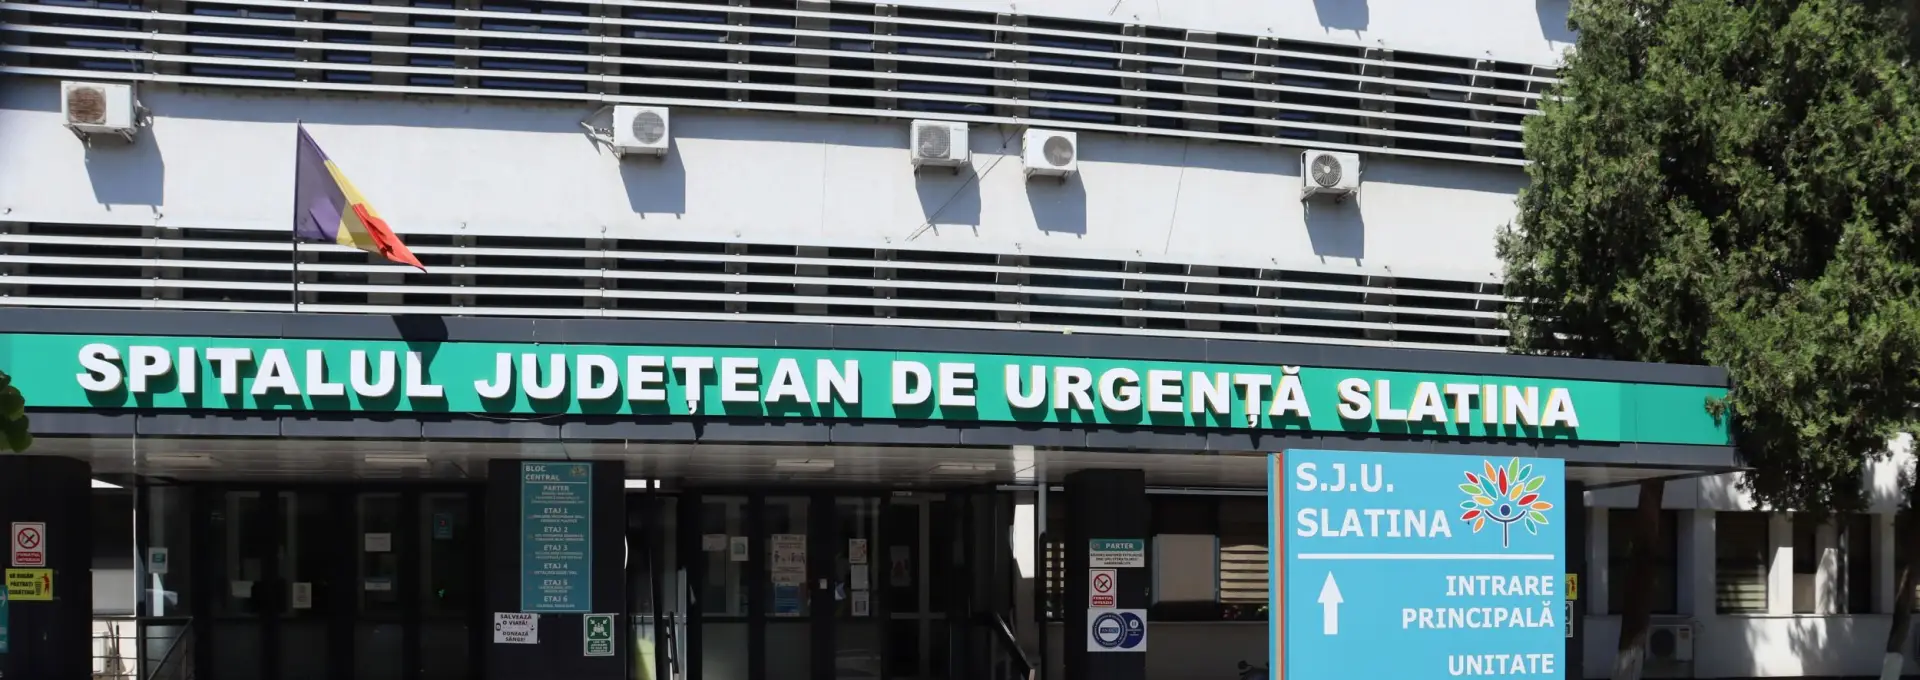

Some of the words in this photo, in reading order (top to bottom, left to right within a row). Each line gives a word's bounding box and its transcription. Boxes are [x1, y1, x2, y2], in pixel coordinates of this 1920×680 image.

[76, 342, 443, 398] SPITALUL
[473, 352, 859, 415] JUDEȚEAN
[891, 360, 976, 407] DE
[1005, 364, 1312, 429] URGENȚĂ
[1335, 377, 1580, 428] SLATINA
[525, 473, 560, 481] CENTRAL
[1296, 462, 1394, 493] S.J.U.
[1297, 507, 1453, 538] SLATINA
[1446, 575, 1554, 597] INTRARE
[1402, 601, 1555, 630] PRINCIPALĂ
[1449, 653, 1555, 676] UNITATE
